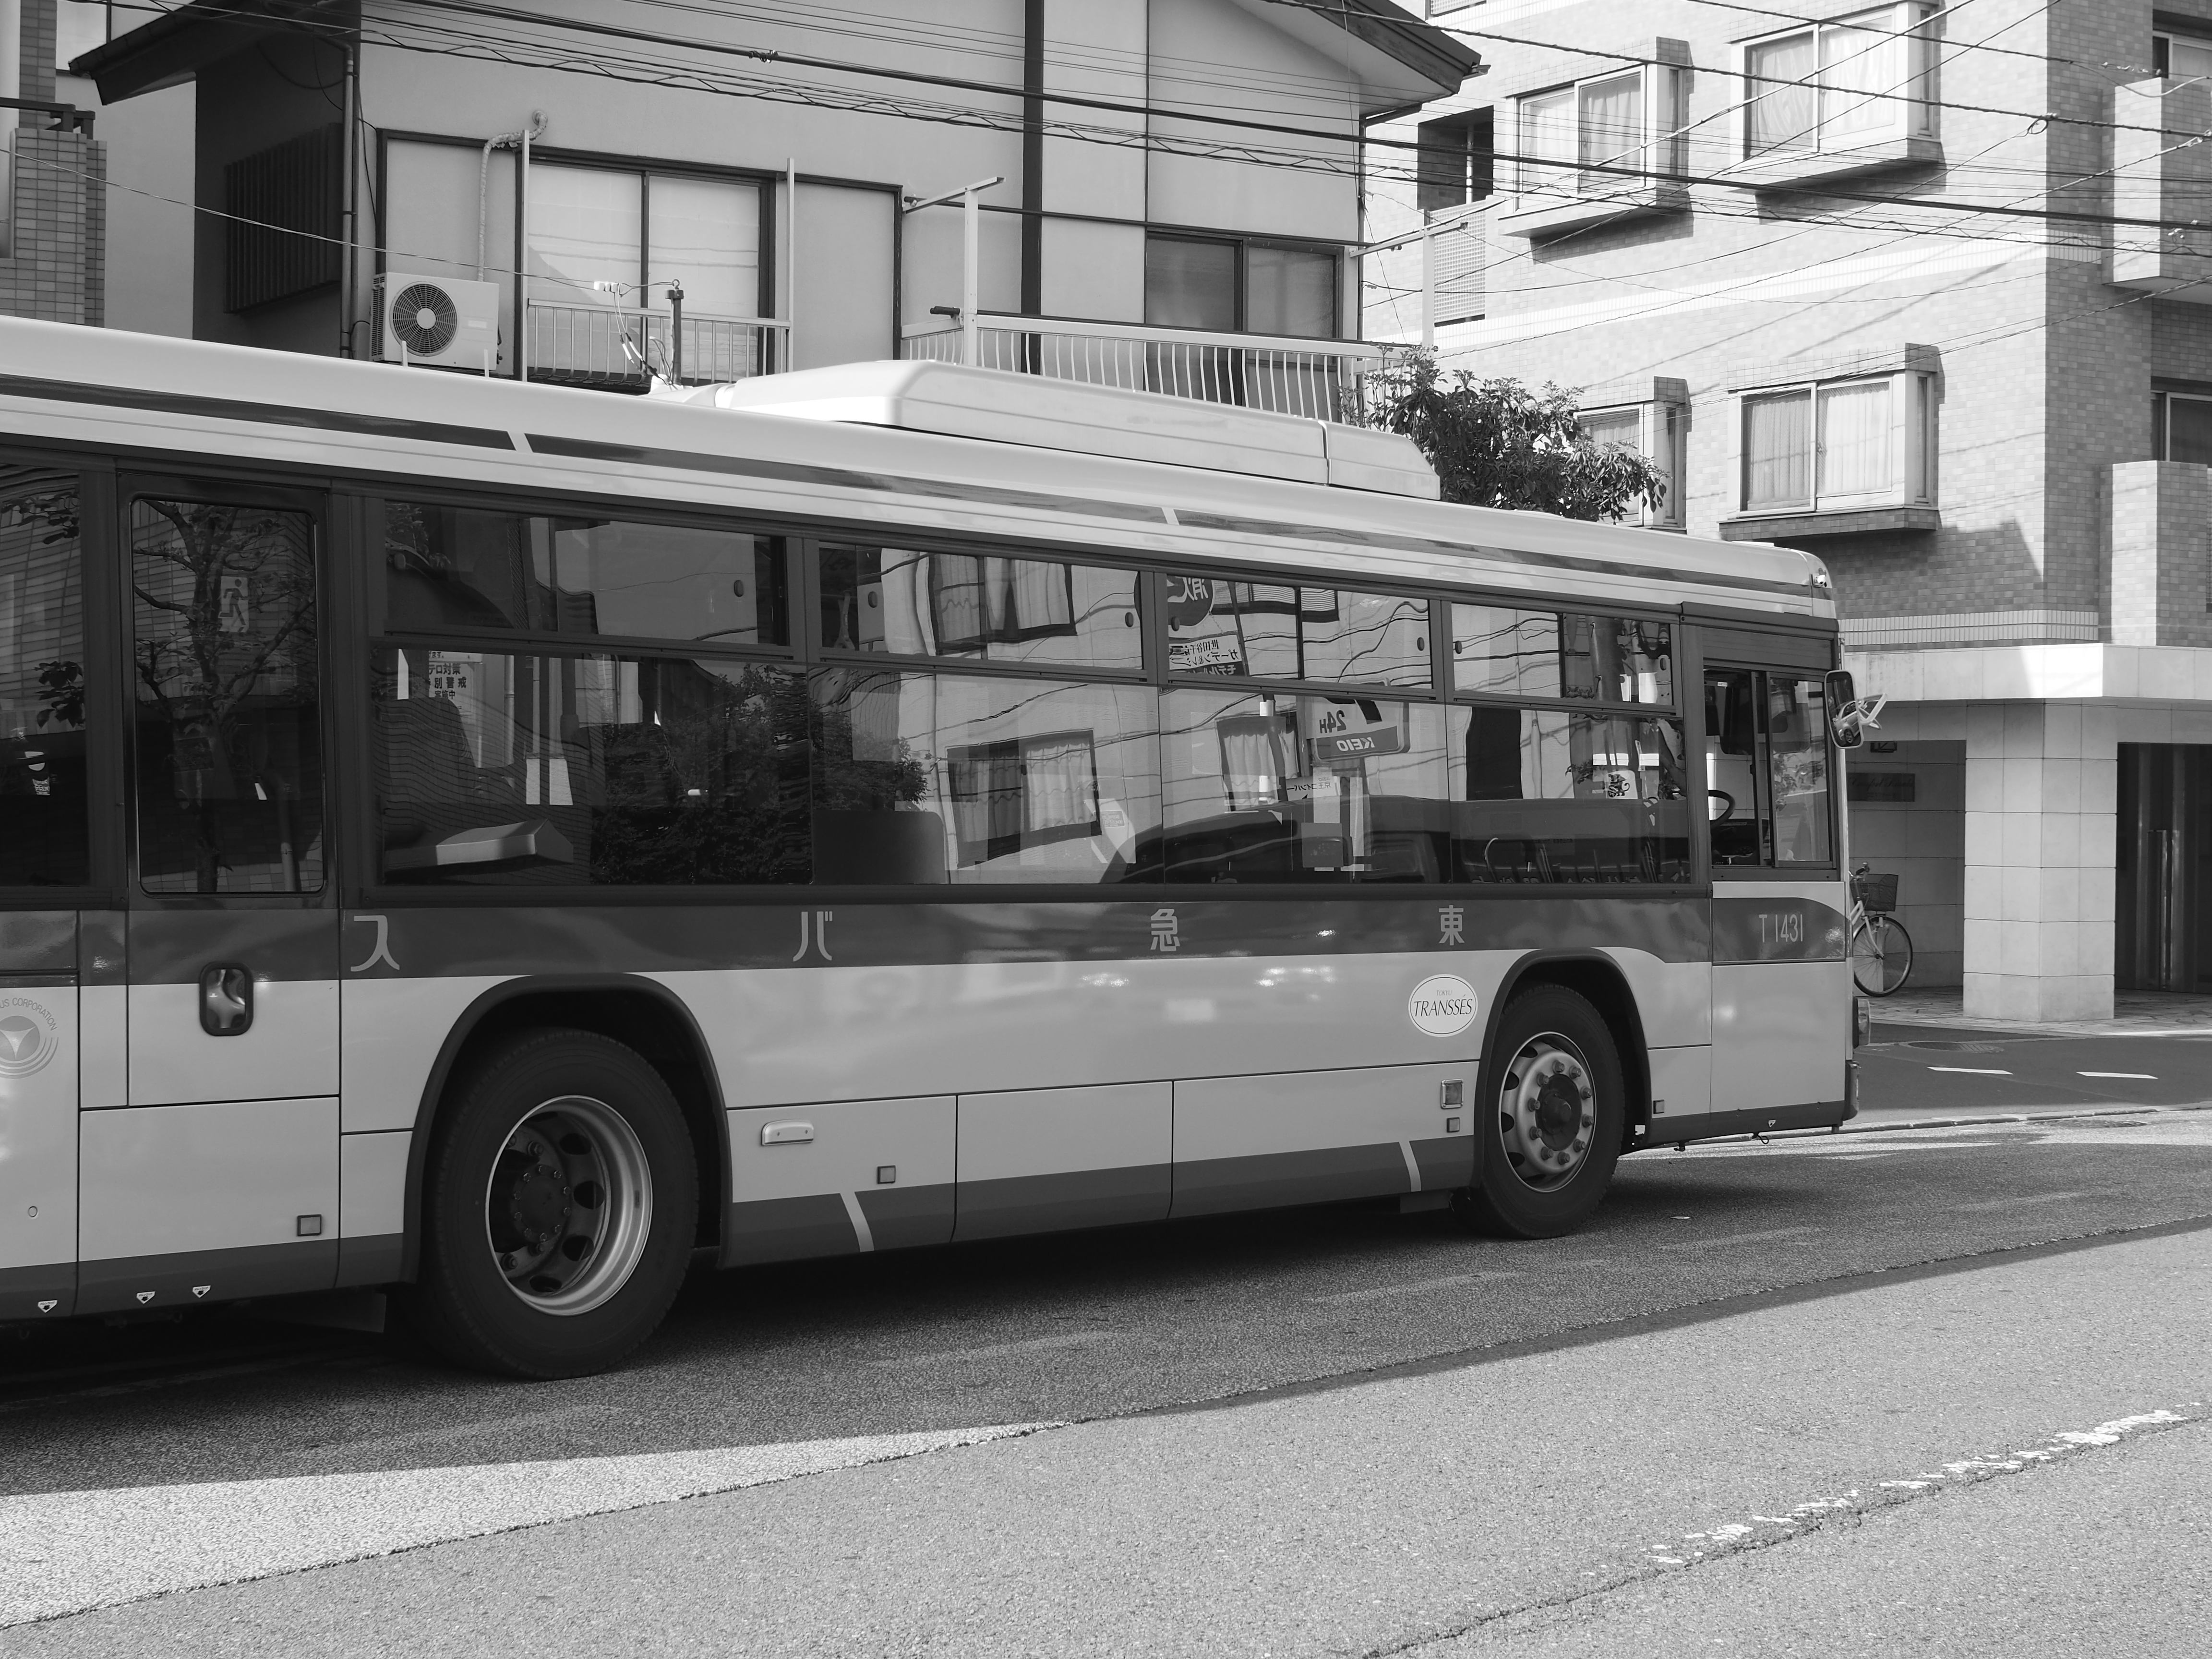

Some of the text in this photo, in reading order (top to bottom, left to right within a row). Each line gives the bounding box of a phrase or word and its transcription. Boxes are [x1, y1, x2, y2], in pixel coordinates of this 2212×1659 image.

[429, 663, 461, 675] テロ対策
[429, 676, 467, 689] 別警戒
[350, 905, 1465, 972] ス バ 急 東
[12, 998, 58, 1031] CORPORATION
[1414, 994, 1473, 1017] TRANSSÉS
